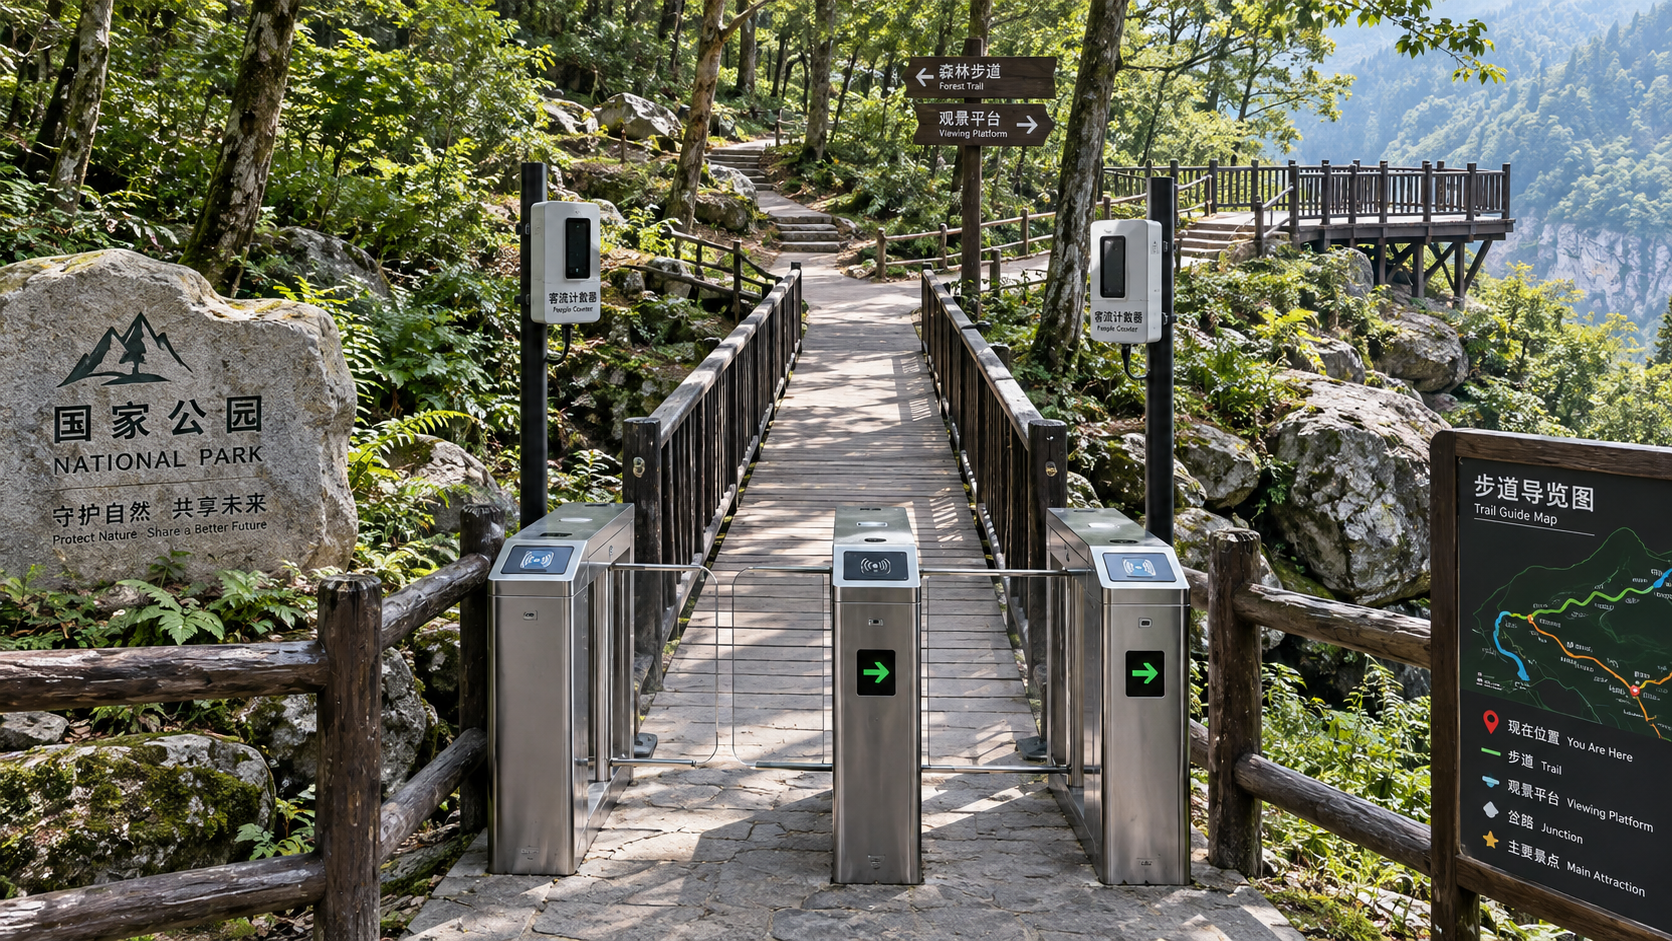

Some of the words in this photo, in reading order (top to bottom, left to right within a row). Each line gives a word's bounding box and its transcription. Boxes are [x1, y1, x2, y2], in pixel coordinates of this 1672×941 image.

[938, 63, 1002, 80] 森林步道
[939, 82, 966, 91] Forest
[967, 82, 984, 91] Trail
[938, 110, 1001, 127] 观景平台
[939, 129, 971, 139] Viewing
[972, 129, 1008, 139] Platform
[54, 395, 263, 443] 国家公园
[53, 450, 187, 475] NATIONAL
[200, 446, 263, 466] PARK
[1474, 473, 1594, 512] 步道导览图
[52, 500, 151, 527] 守护自然
[172, 492, 267, 519] 共享未来
[1474, 503, 1497, 516] Trail
[1499, 506, 1530, 521] Guide
[1533, 512, 1558, 526] Map
[52, 533, 95, 545] Protect
[98, 530, 138, 542] Nature
[147, 525, 181, 538] Share
[184, 527, 191, 535] a
[195, 522, 229, 534] Better
[231, 520, 268, 532] Future
[1507, 719, 1560, 746] 现在位置
[1566, 736, 1586, 750] You
[1588, 743, 1606, 755] Are
[1608, 747, 1633, 763] Here
[1507, 750, 1534, 769] 步道
[1541, 760, 1562, 775] Trail
[1507, 779, 1560, 806] 观景平台
[1566, 797, 1606, 820] Viewing
[1609, 810, 1654, 833] Platform
[1540, 822, 1583, 844] Junction
[1507, 839, 1560, 870] 主要景点
[1566, 861, 1591, 878] Main
[1593, 871, 1646, 897] Attraction
